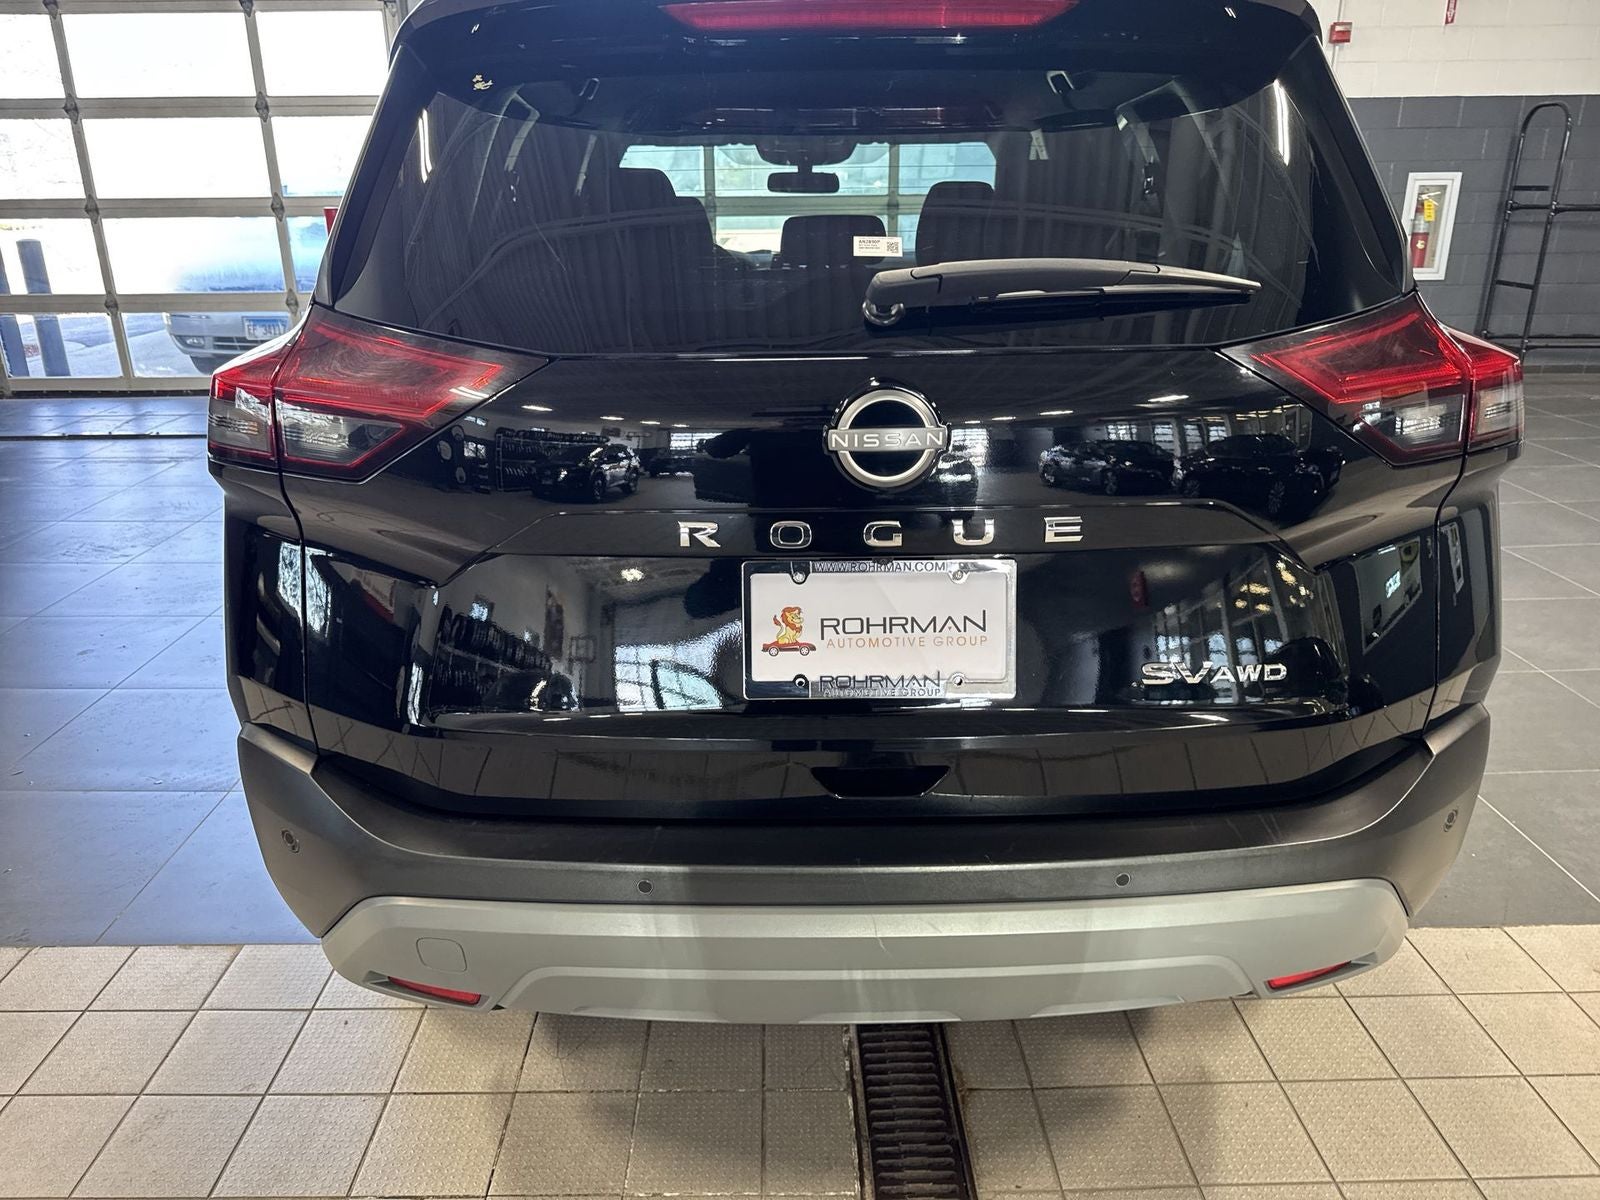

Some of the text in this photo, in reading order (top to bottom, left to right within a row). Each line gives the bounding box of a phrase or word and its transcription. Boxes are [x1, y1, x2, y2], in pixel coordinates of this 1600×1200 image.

[830, 431, 944, 448] NISSAN
[677, 515, 1084, 549] ROGUE
[814, 561, 946, 572] WWW.ROHRMAN.COM
[820, 610, 986, 640] ROHRMAN
[826, 635, 988, 649] AUTOMOTIVE GROUP
[819, 670, 941, 692] ROHRMAN
[823, 687, 941, 698] AUTOMOTIVE GROUP
